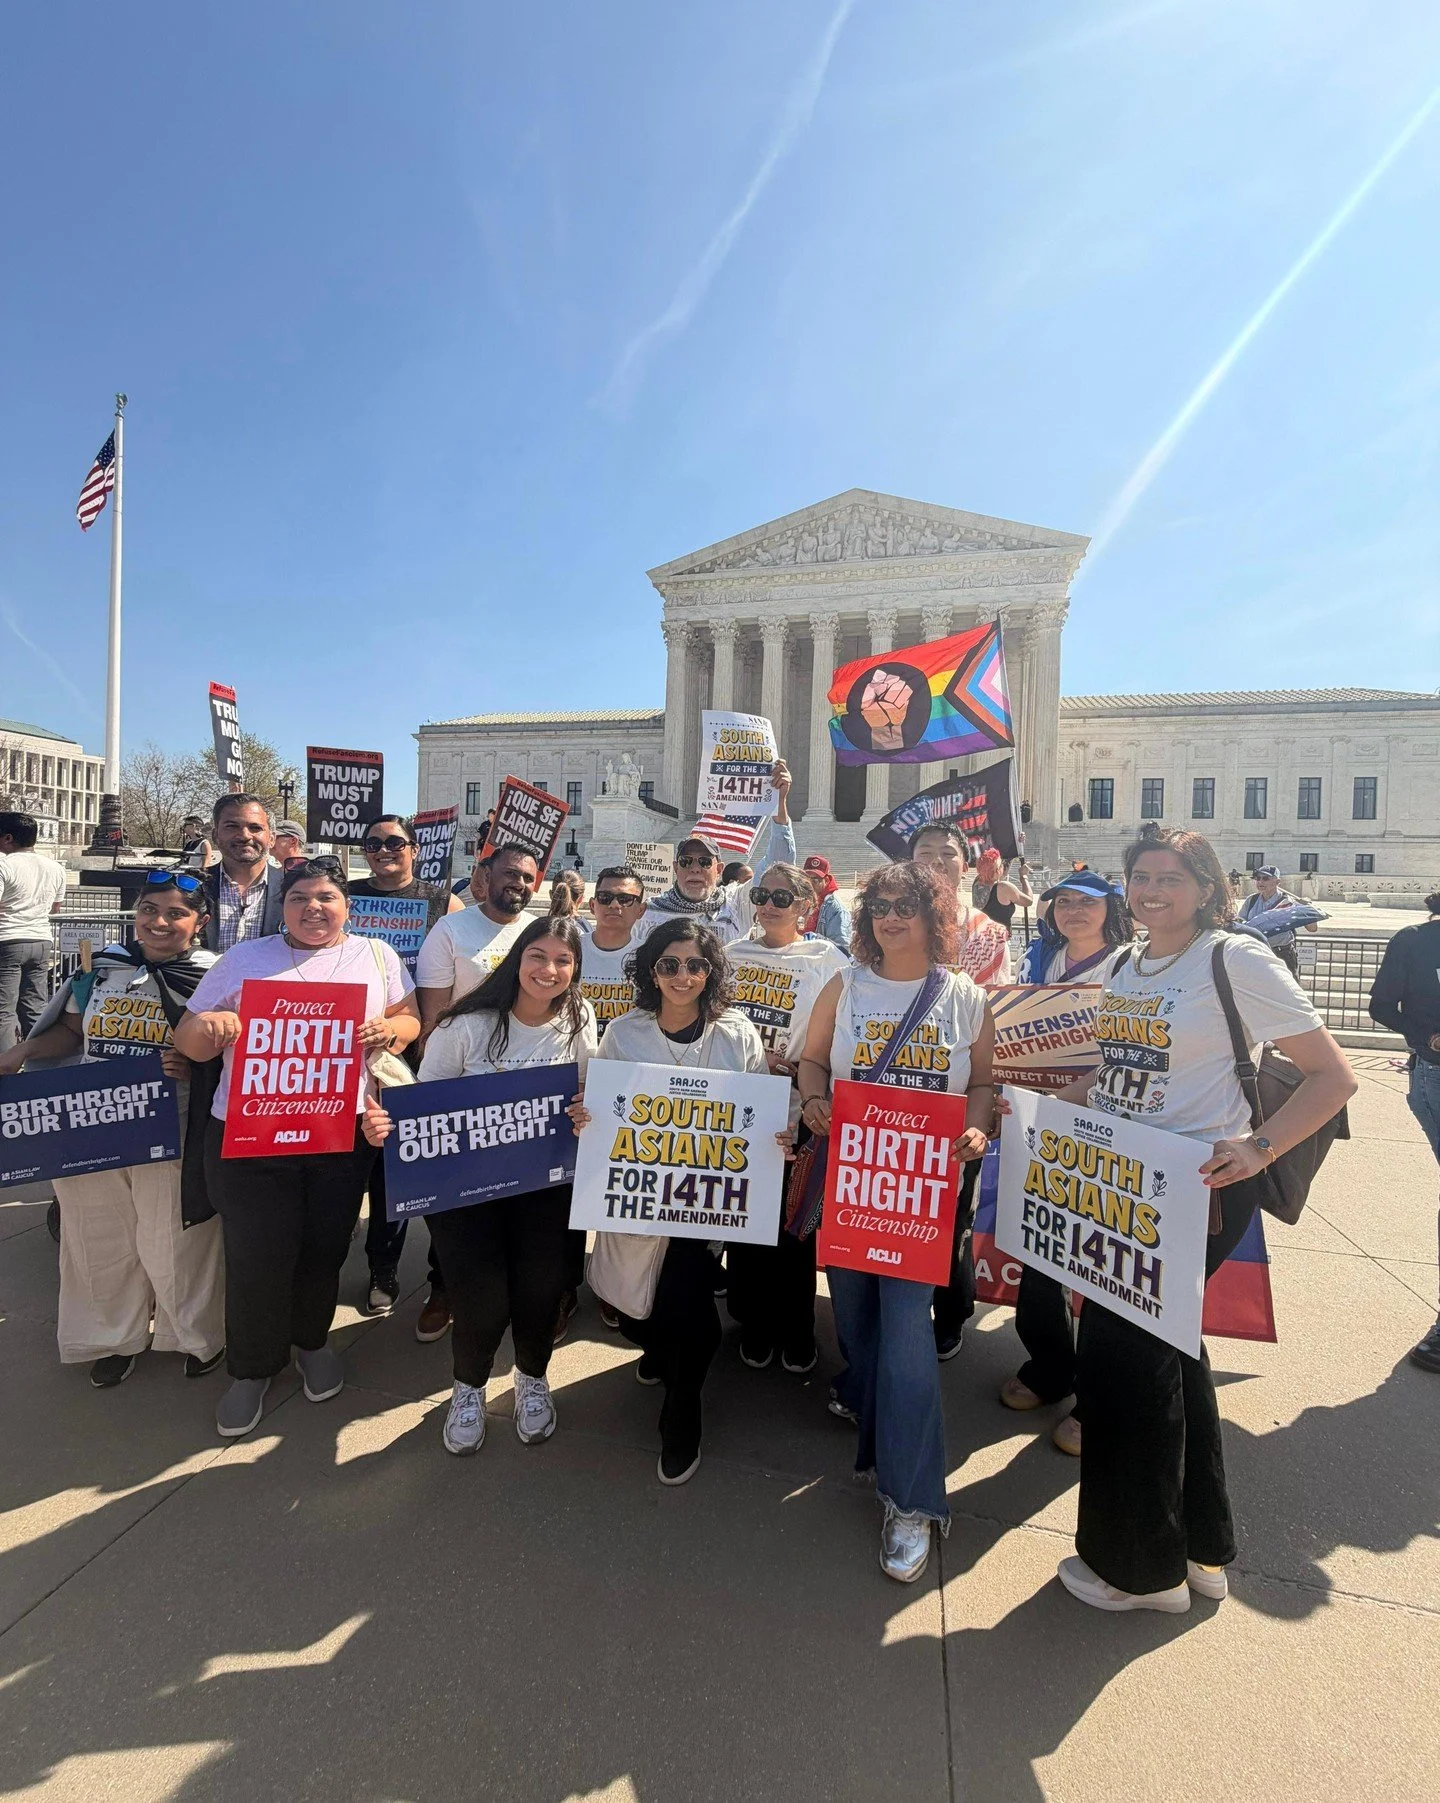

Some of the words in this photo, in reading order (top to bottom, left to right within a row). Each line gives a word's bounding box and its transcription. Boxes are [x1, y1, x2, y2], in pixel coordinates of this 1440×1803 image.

[720, 728, 765, 745] SOUTH
[231, 741, 242, 759] G
[712, 744, 773, 762] ASIANS
[312, 764, 380, 784] TRUMP
[319, 783, 372, 802] MUST
[718, 777, 763, 794] 14TH
[331, 803, 358, 820] GO
[506, 790, 540, 817] ¡QUE
[540, 805, 561, 828] SE
[890, 809, 920, 835] NO
[915, 793, 963, 821] TRUMP
[415, 821, 457, 843] TRUMP
[499, 807, 553, 847] LARGUE
[420, 861, 441, 879] GO
[625, 862, 670, 872] CONSTITUTION!
[350, 898, 424, 916] RTHRIGHT
[349, 915, 424, 930] TIZENSHIP
[735, 966, 793, 989] SOUTH
[581, 983, 633, 1000] SOUTH
[734, 983, 797, 1011] SIANS
[271, 998, 336, 1016] Protect
[753, 1009, 771, 1020] THE
[246, 1018, 354, 1054] BIRTH
[865, 1020, 939, 1045] SOTH
[994, 1006, 1098, 1044] ITIZENSHI
[1095, 1014, 1171, 1049] SIANS
[103, 1043, 124, 1055] FOR
[994, 1025, 1096, 1060] BIRTHRIGH
[852, 1042, 951, 1072] ASANS
[1104, 1047, 1125, 1059] FOR
[1125, 1049, 1142, 1061] THE
[241, 1057, 353, 1095] RIGHT
[670, 1077, 708, 1088] SAAJCO
[882, 1072, 897, 1084] OR
[899, 1075, 923, 1087] THE
[992, 1069, 1042, 1081] PROTECT
[1047, 1073, 1073, 1084] THE
[0, 1081, 169, 1121] BIRTHRIGHT.
[242, 1096, 344, 1116] Citizenship
[2, 1115, 61, 1139] OUR
[69, 1101, 155, 1129] RIGHT.
[398, 1095, 570, 1141] BIRTHRIGHT.
[629, 1094, 735, 1133] SOUTH
[862, 1104, 930, 1129] Protect
[273, 1130, 310, 1144] ACLU
[1074, 1117, 1113, 1137] SAAJCO
[399, 1133, 460, 1162] OUR
[469, 1117, 556, 1150] RIGHT.
[609, 1127, 750, 1173] ASIANS
[839, 1123, 949, 1176] BIRTH
[61, 1154, 120, 1169] defendbirthright.com
[1038, 1129, 1145, 1197] SOUTH
[11, 1172, 34, 1180] CAUCUS
[459, 1180, 519, 1197] defendbirthright.com
[607, 1167, 658, 1193] FOR
[661, 1172, 750, 1212] 14TH
[835, 1165, 948, 1219] RIGHT
[406, 1197, 424, 1206] ASIAN
[406, 1202, 430, 1212] CAUCUS
[604, 1194, 655, 1220] THE
[657, 1208, 748, 1228] AMENDMENT
[1024, 1159, 1161, 1249] ASIANS
[836, 1209, 938, 1243] Citizenship
[866, 1247, 902, 1265] ACLU
[1022, 1197, 1067, 1240] FOR
[1070, 1222, 1164, 1301] 14TH
[1020, 1223, 1066, 1269] THE
[1068, 1259, 1163, 1320] AMENDMENT
